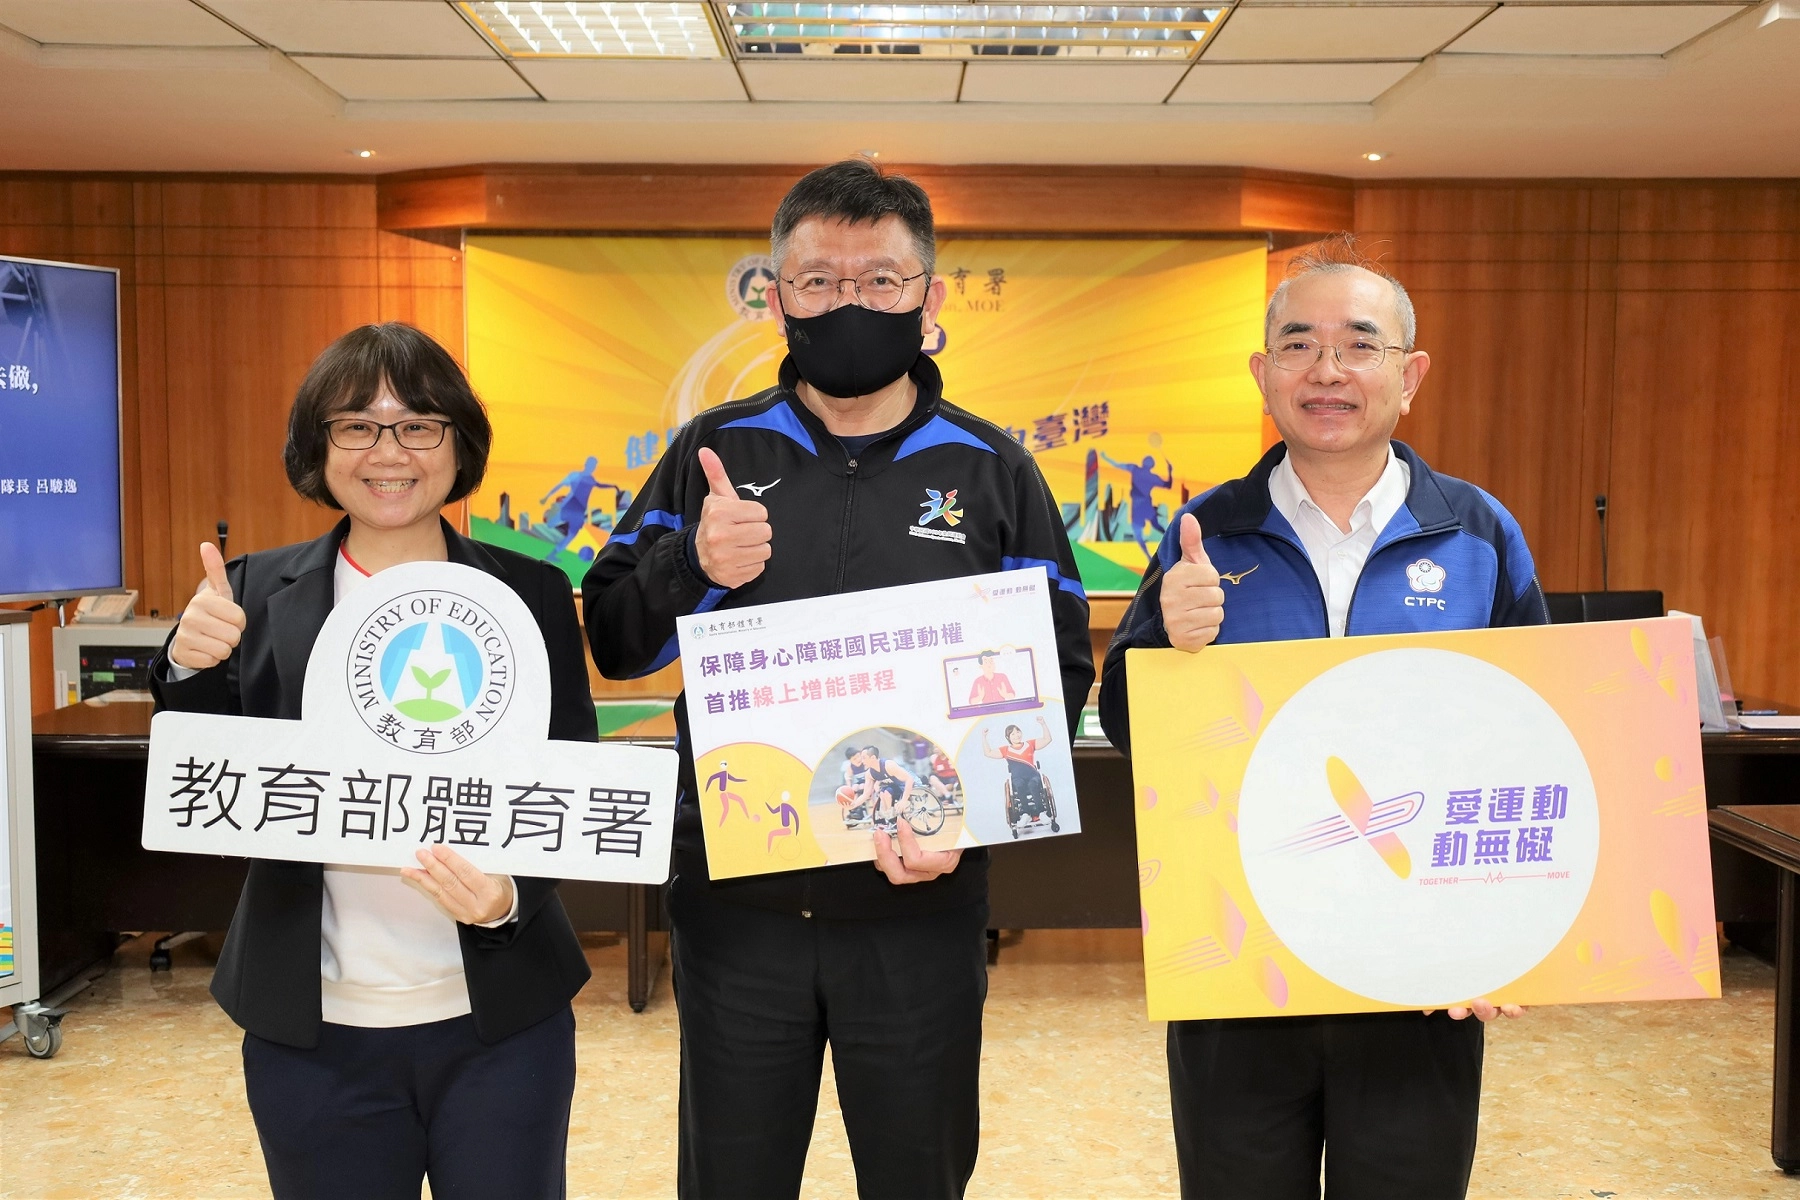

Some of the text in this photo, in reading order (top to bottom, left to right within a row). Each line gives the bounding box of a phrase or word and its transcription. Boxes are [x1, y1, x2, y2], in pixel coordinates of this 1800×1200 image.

[1005, 401, 1109, 453] 臺灣
[1404, 596, 1446, 611] CTPC
[354, 598, 507, 723] MINISTRY OF EDUCATION
[700, 622, 964, 678] 保障身心障礙國民運動權
[704, 669, 897, 714] 首推線上增能課程
[376, 712, 476, 751] 教育部
[168, 756, 652, 859] 教育部體育署
[1445, 783, 1569, 826] 愛運動
[1431, 826, 1554, 868] 動無礙
[1418, 876, 1459, 886] TOGETHER
[1547, 870, 1571, 880] MOVE
